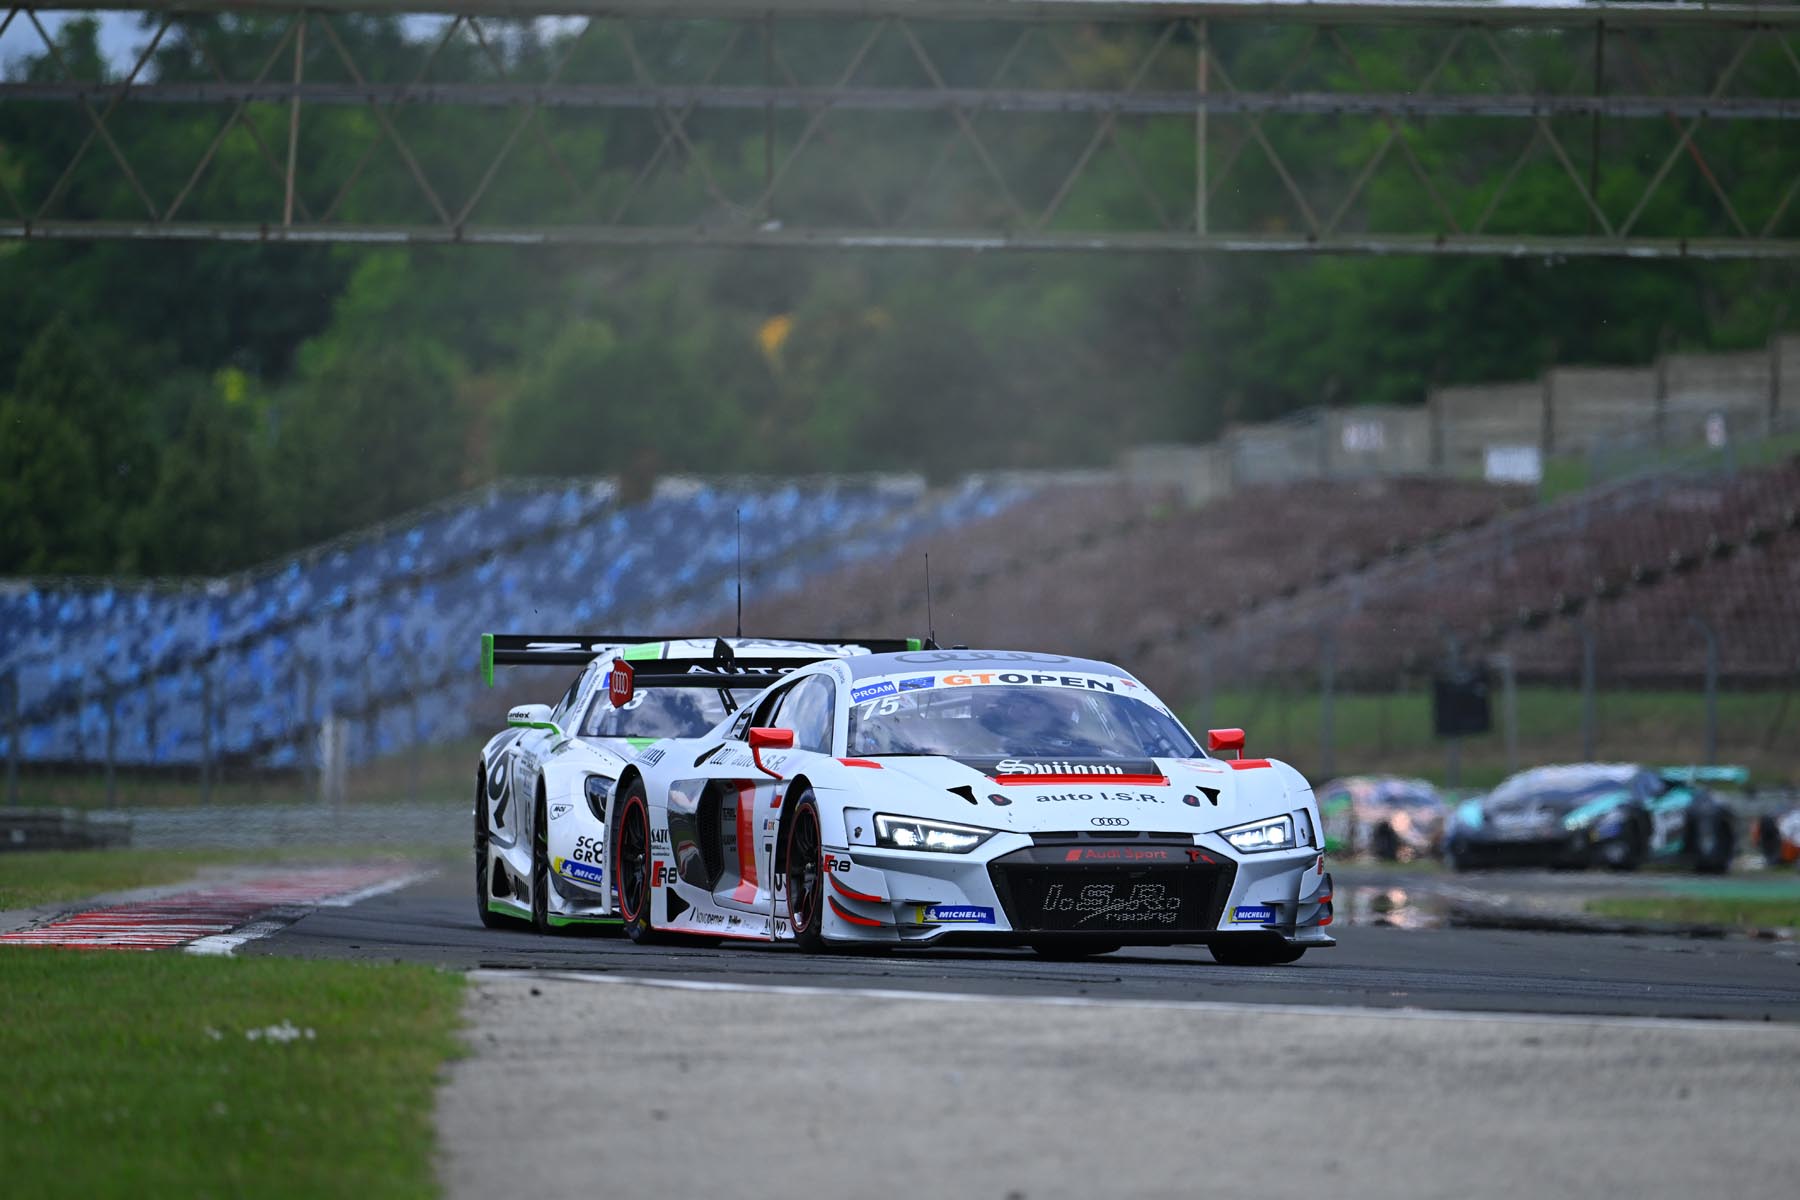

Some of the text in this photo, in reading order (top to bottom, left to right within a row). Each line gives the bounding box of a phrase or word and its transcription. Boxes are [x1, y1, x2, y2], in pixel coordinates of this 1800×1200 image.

[852, 684, 894, 700] PROAM
[860, 696, 900, 721] 75
[1036, 792, 1165, 804] auto I.S.R.
[1085, 847, 1168, 860] Audi Sport
[828, 859, 851, 873] R8
[658, 867, 678, 885] R8
[938, 911, 987, 919] MICHELIN
[1237, 911, 1271, 919] MICHELIN
